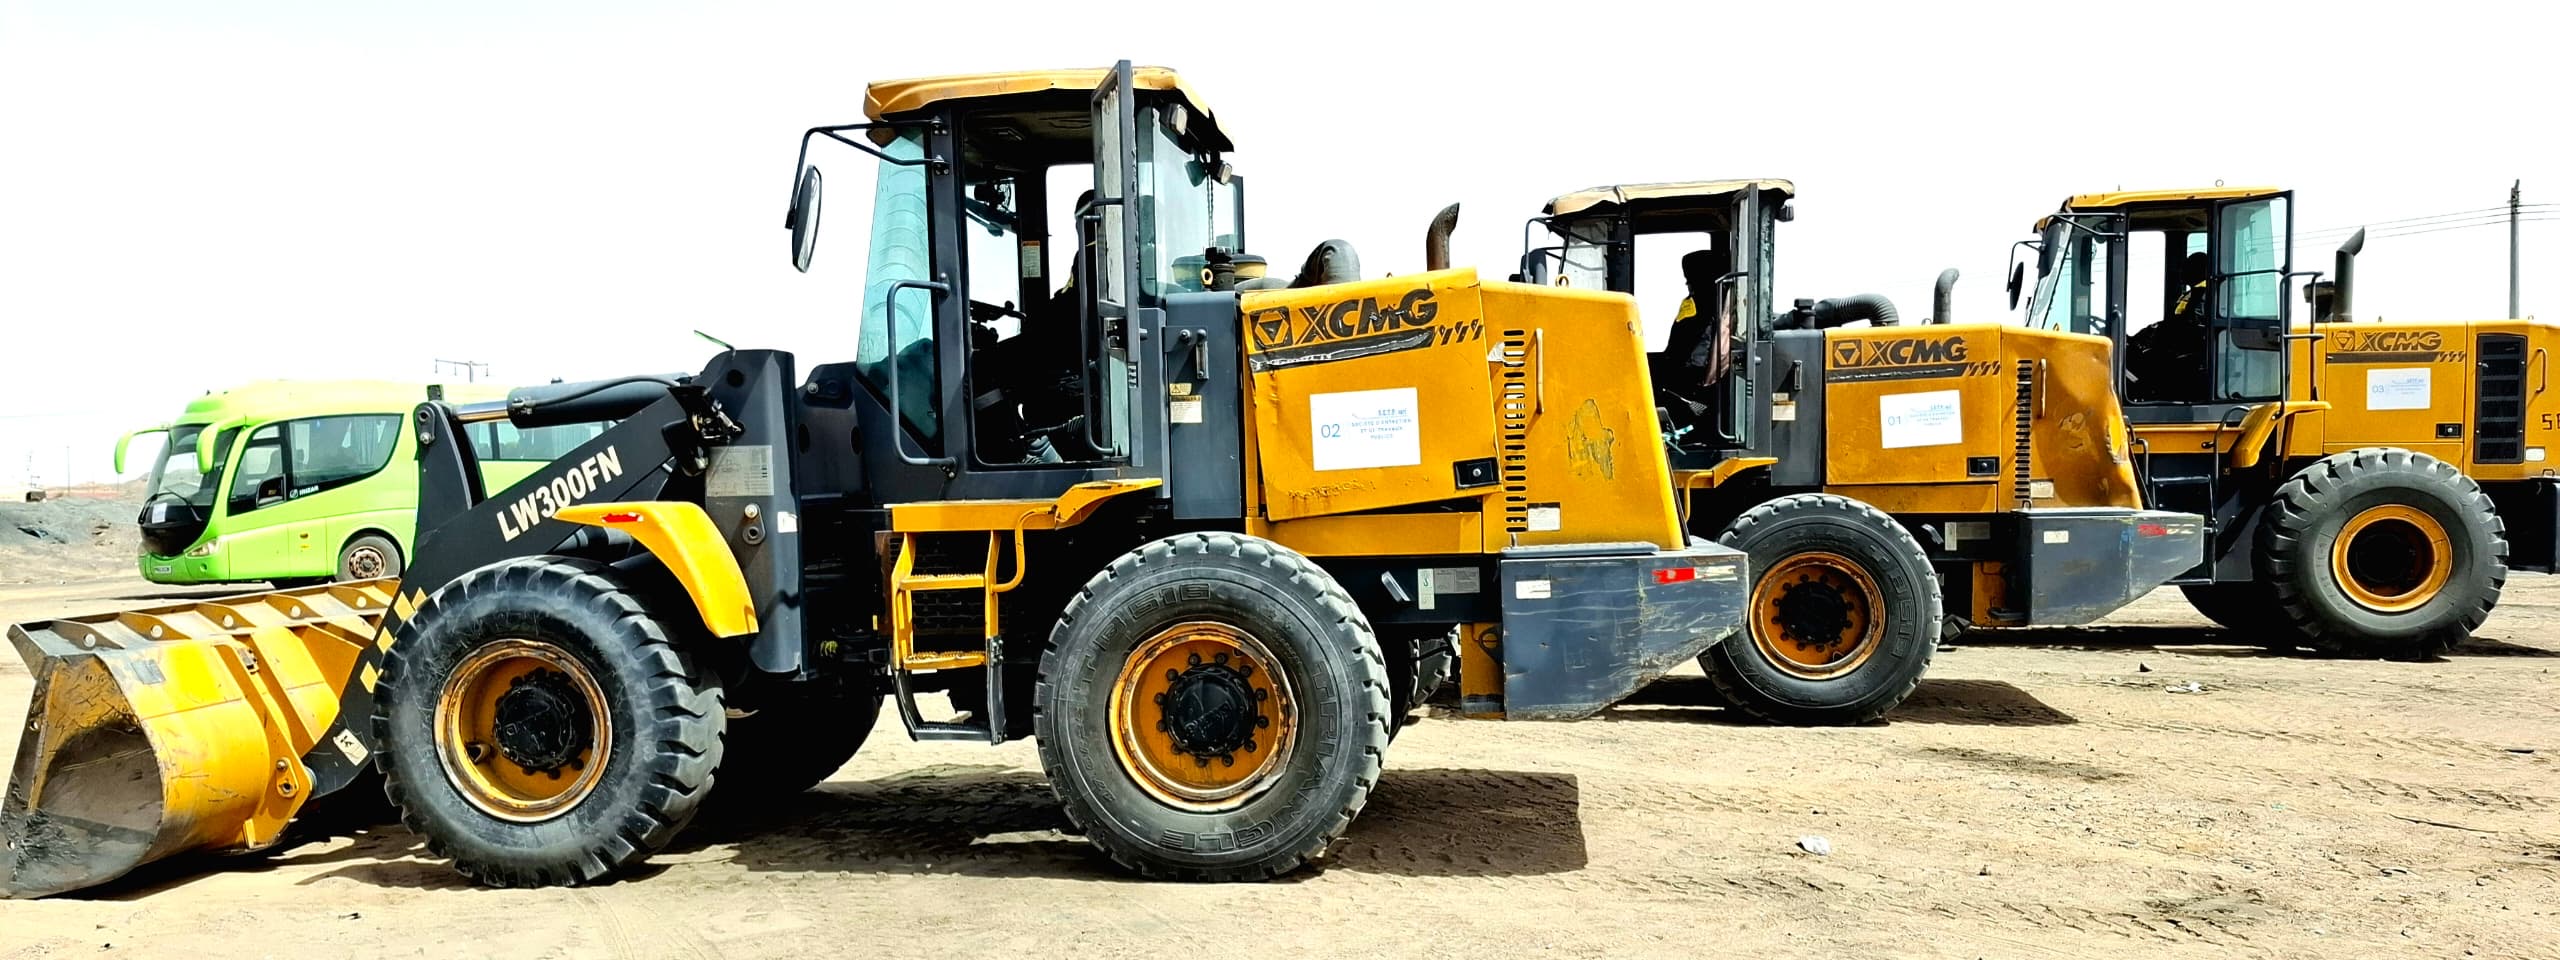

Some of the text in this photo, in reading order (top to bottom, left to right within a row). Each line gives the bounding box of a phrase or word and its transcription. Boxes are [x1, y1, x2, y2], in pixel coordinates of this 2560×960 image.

[1295, 288, 1438, 345] XCMG
[1863, 336, 1968, 367] XCMG
[2356, 331, 2442, 352] XCMG
[2372, 384, 2385, 393] 03
[1321, 423, 1341, 438] 02
[1888, 415, 1901, 426] 01
[496, 445, 623, 542] LW300FN
